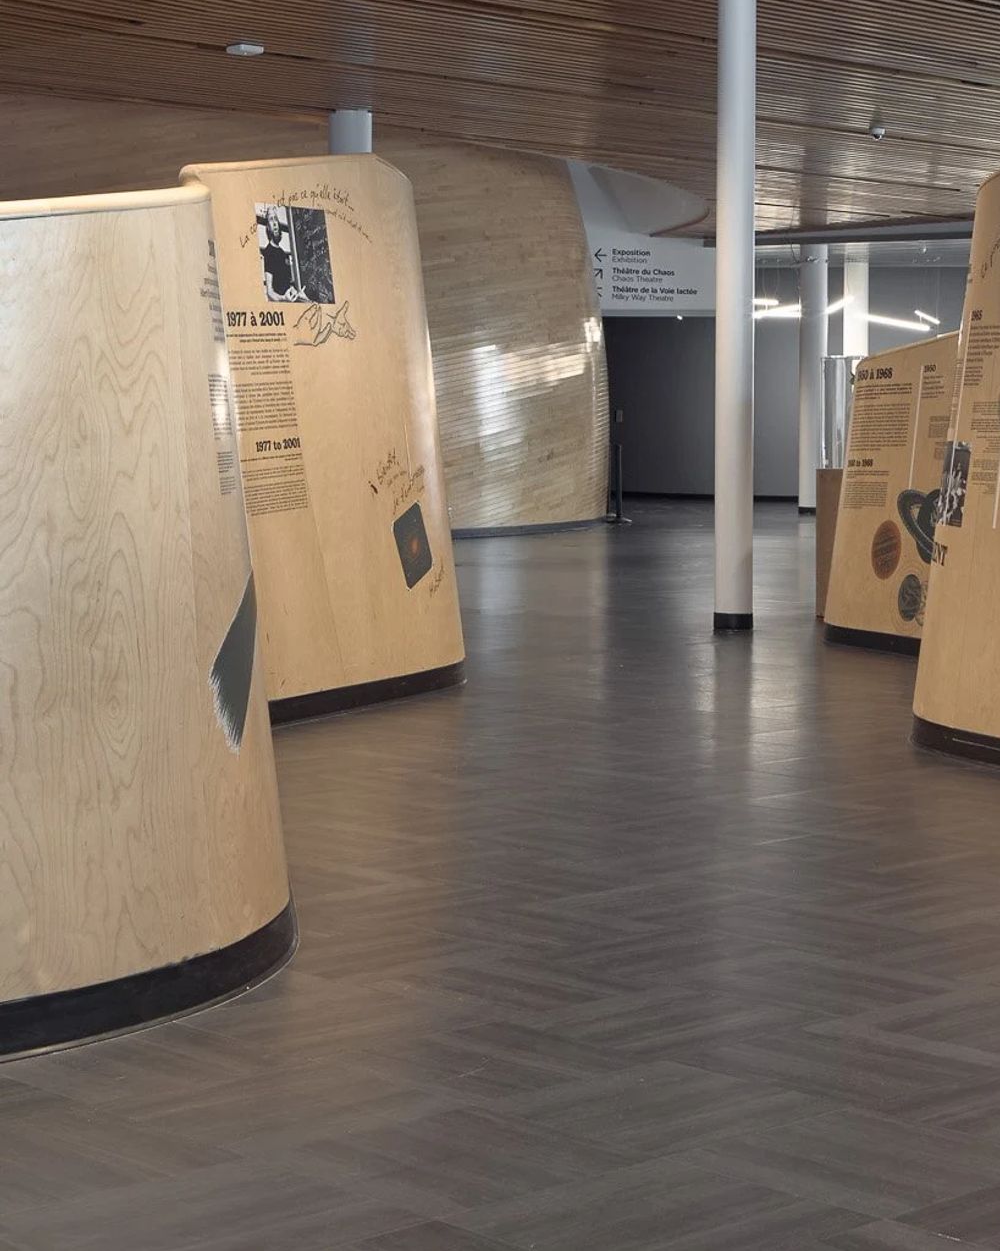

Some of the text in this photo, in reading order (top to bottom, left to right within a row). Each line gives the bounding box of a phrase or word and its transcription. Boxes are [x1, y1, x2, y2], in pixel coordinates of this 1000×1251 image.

[612, 248, 651, 257] Exposition
[612, 266, 640, 275] Théâtre
[652, 268, 675, 276] Chaos
[611, 275, 663, 283] Chaos Theatre
[612, 285, 639, 293] Théâtre
[676, 287, 698, 295] lactée
[611, 293, 674, 302] Milky Way Theatre
[226, 310, 285, 327] 1977 à 2001
[273, 438, 282, 451] to
